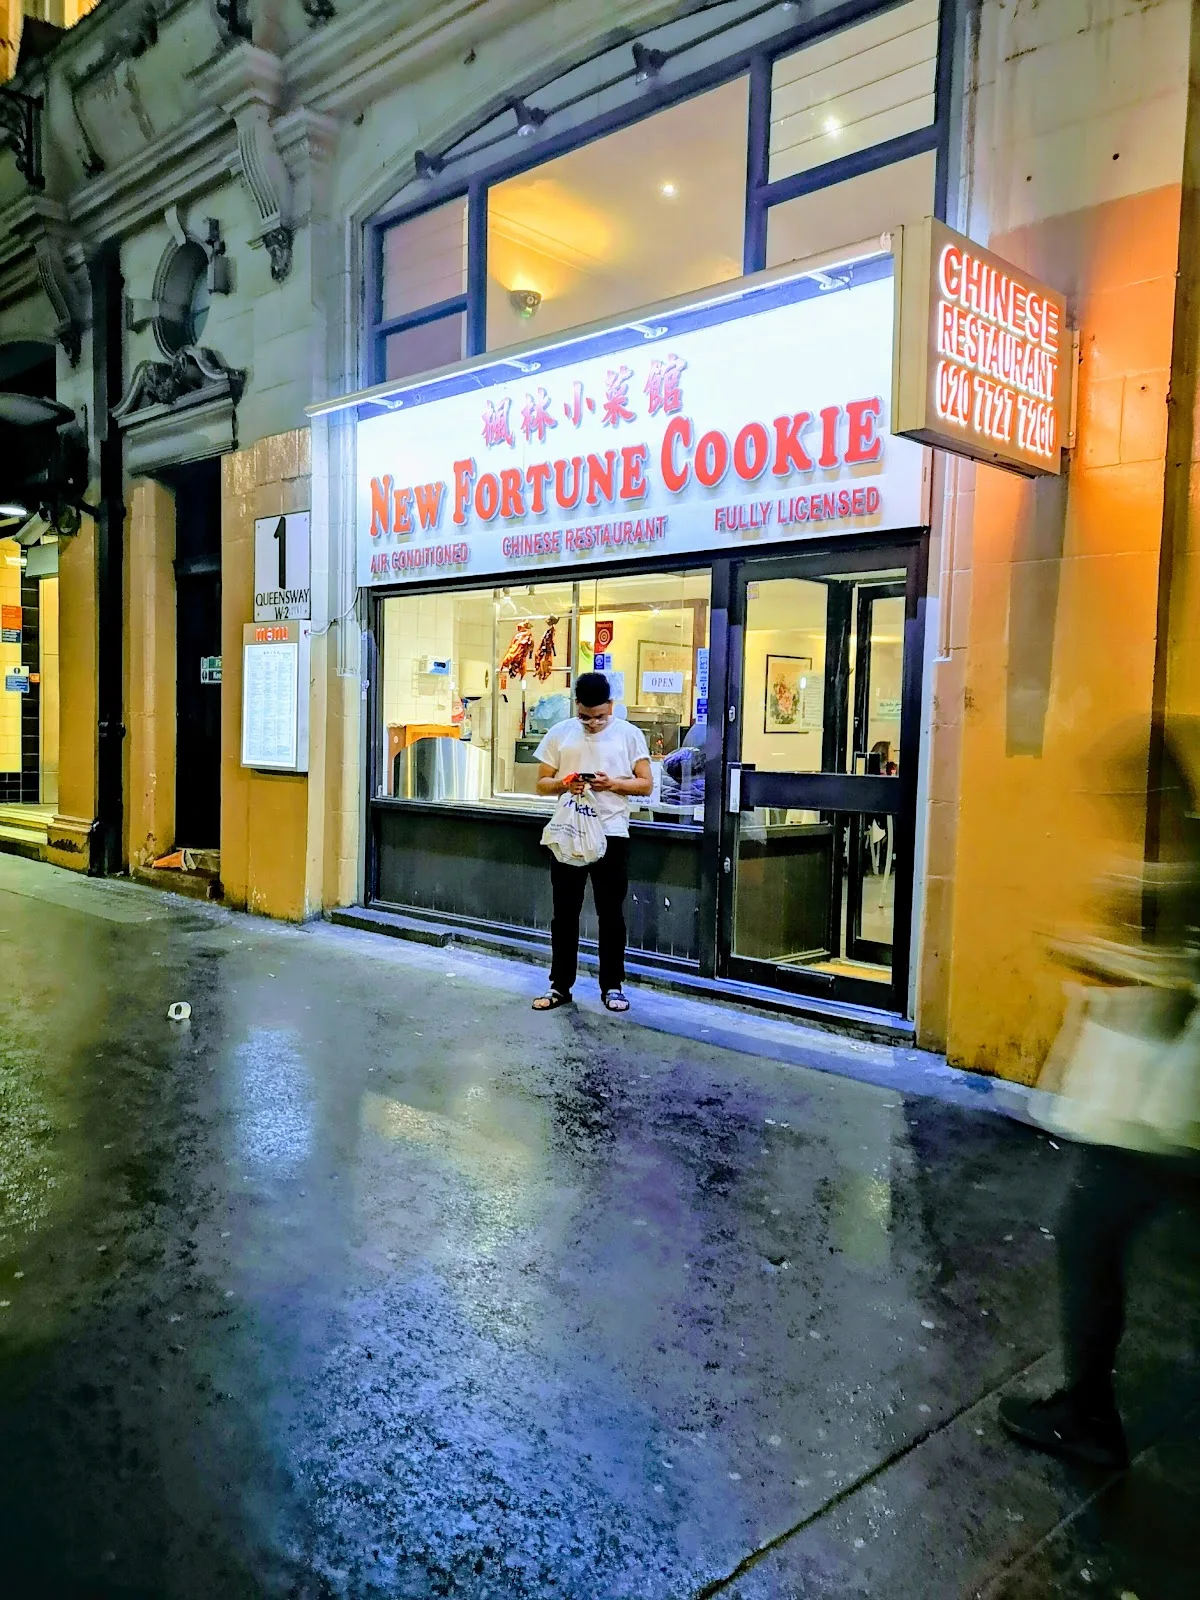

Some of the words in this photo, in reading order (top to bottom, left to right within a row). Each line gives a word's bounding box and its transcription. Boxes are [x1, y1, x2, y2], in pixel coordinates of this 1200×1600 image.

[938, 243, 1060, 353] CHINESE
[937, 301, 1058, 402] RESTAURANT
[936, 360, 972, 426] 020
[974, 376, 1016, 441] 7727
[1018, 394, 1057, 457] 7260
[452, 444, 650, 526] FORTUNE
[660, 395, 883, 494] COOKIE
[273, 516, 287, 590] 1
[370, 554, 390, 573] AIR
[391, 542, 470, 570] CONDITIONED
[502, 532, 561, 558] CHINESE
[564, 515, 668, 551] RESTAURANT
[714, 501, 772, 532] FULLY
[777, 486, 881, 525] LICENSED
[255, 588, 310, 607] QUEENSWAY
[651, 677, 675, 688] OPEN
